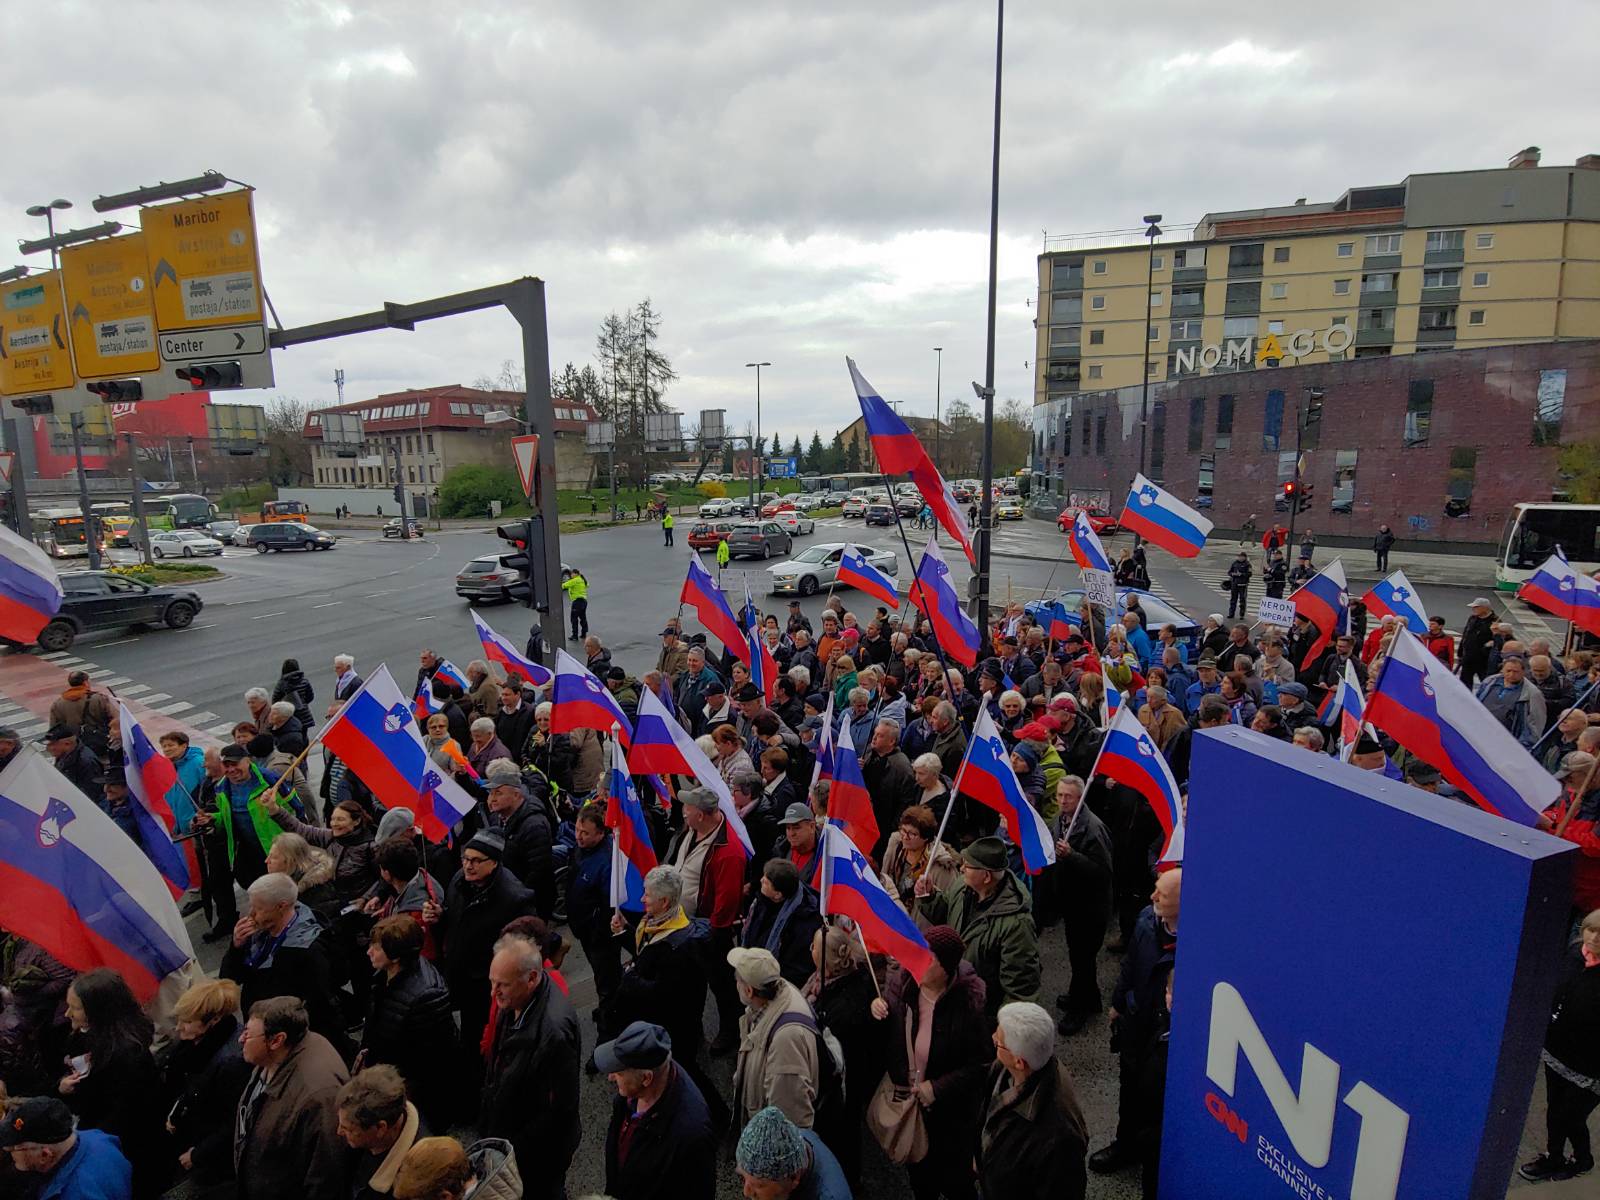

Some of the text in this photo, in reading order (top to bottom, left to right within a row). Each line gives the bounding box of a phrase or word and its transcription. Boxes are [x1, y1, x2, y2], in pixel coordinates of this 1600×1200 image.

[174, 209, 221, 228] Maribor
[190, 297, 252, 318] postaja/station
[165, 338, 204, 355] Center
[1175, 323, 1356, 374] NOMAGO
[1260, 600, 1292, 613] NERON
[1206, 981, 1410, 1200] N1
[1205, 1092, 1249, 1143] CNN
[1258, 1134, 1326, 1200] EXCLUSIVE
